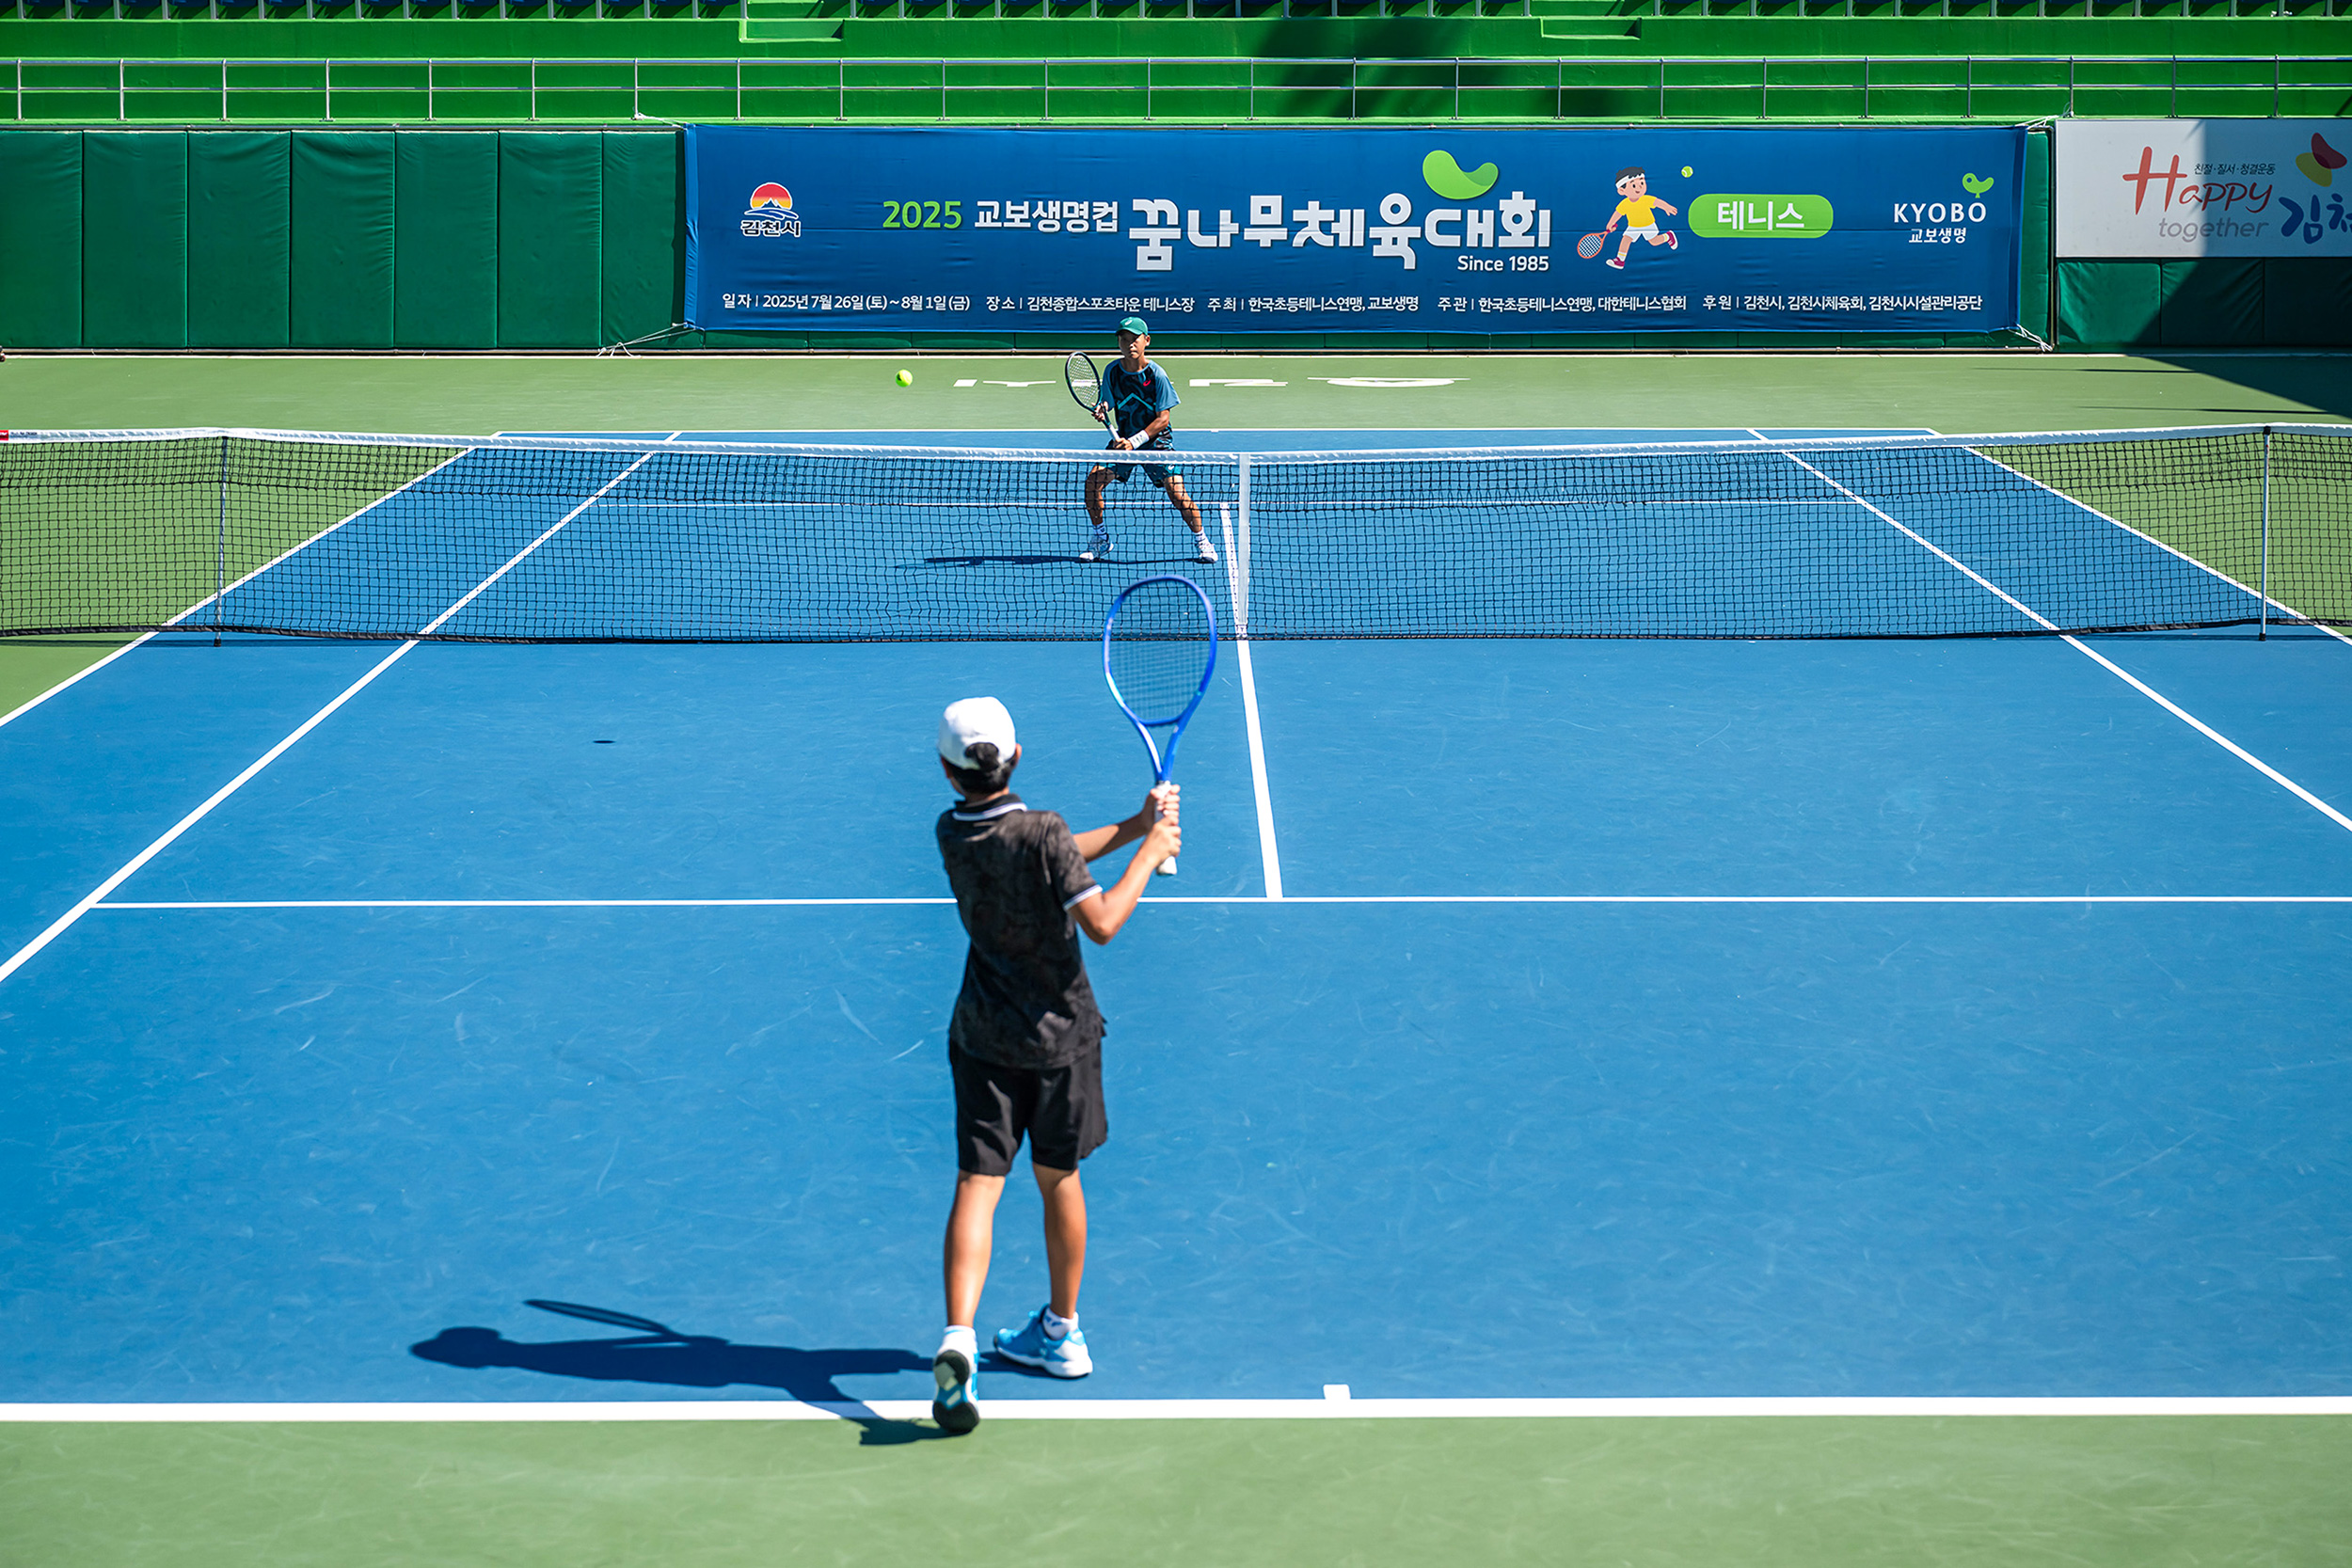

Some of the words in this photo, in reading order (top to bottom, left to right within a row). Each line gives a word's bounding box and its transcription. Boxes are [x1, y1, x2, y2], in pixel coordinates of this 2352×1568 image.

[2122, 146, 2273, 214] Happy
[882, 200, 961, 229] 2025
[974, 200, 1119, 233] 교보생명컵
[1717, 200, 1805, 231] 테니스
[1893, 202, 1987, 223] KYOBO
[740, 218, 802, 238] 김천시
[1908, 228, 1967, 245] 교보생명
[2159, 217, 2269, 243] together
[1457, 255, 1504, 272] Since
[1509, 255, 1549, 272] 1985
[762, 294, 809, 309] 2025년
[811, 294, 833, 310] 7월
[1026, 296, 1142, 312] 김천종합스포츠타운
[1144, 296, 1196, 312] 테니스장
[1368, 295, 1419, 311] 교보생명
[1597, 295, 1687, 311] 대한테니스협회
[1868, 294, 1983, 311] 김천시시설관리공단
